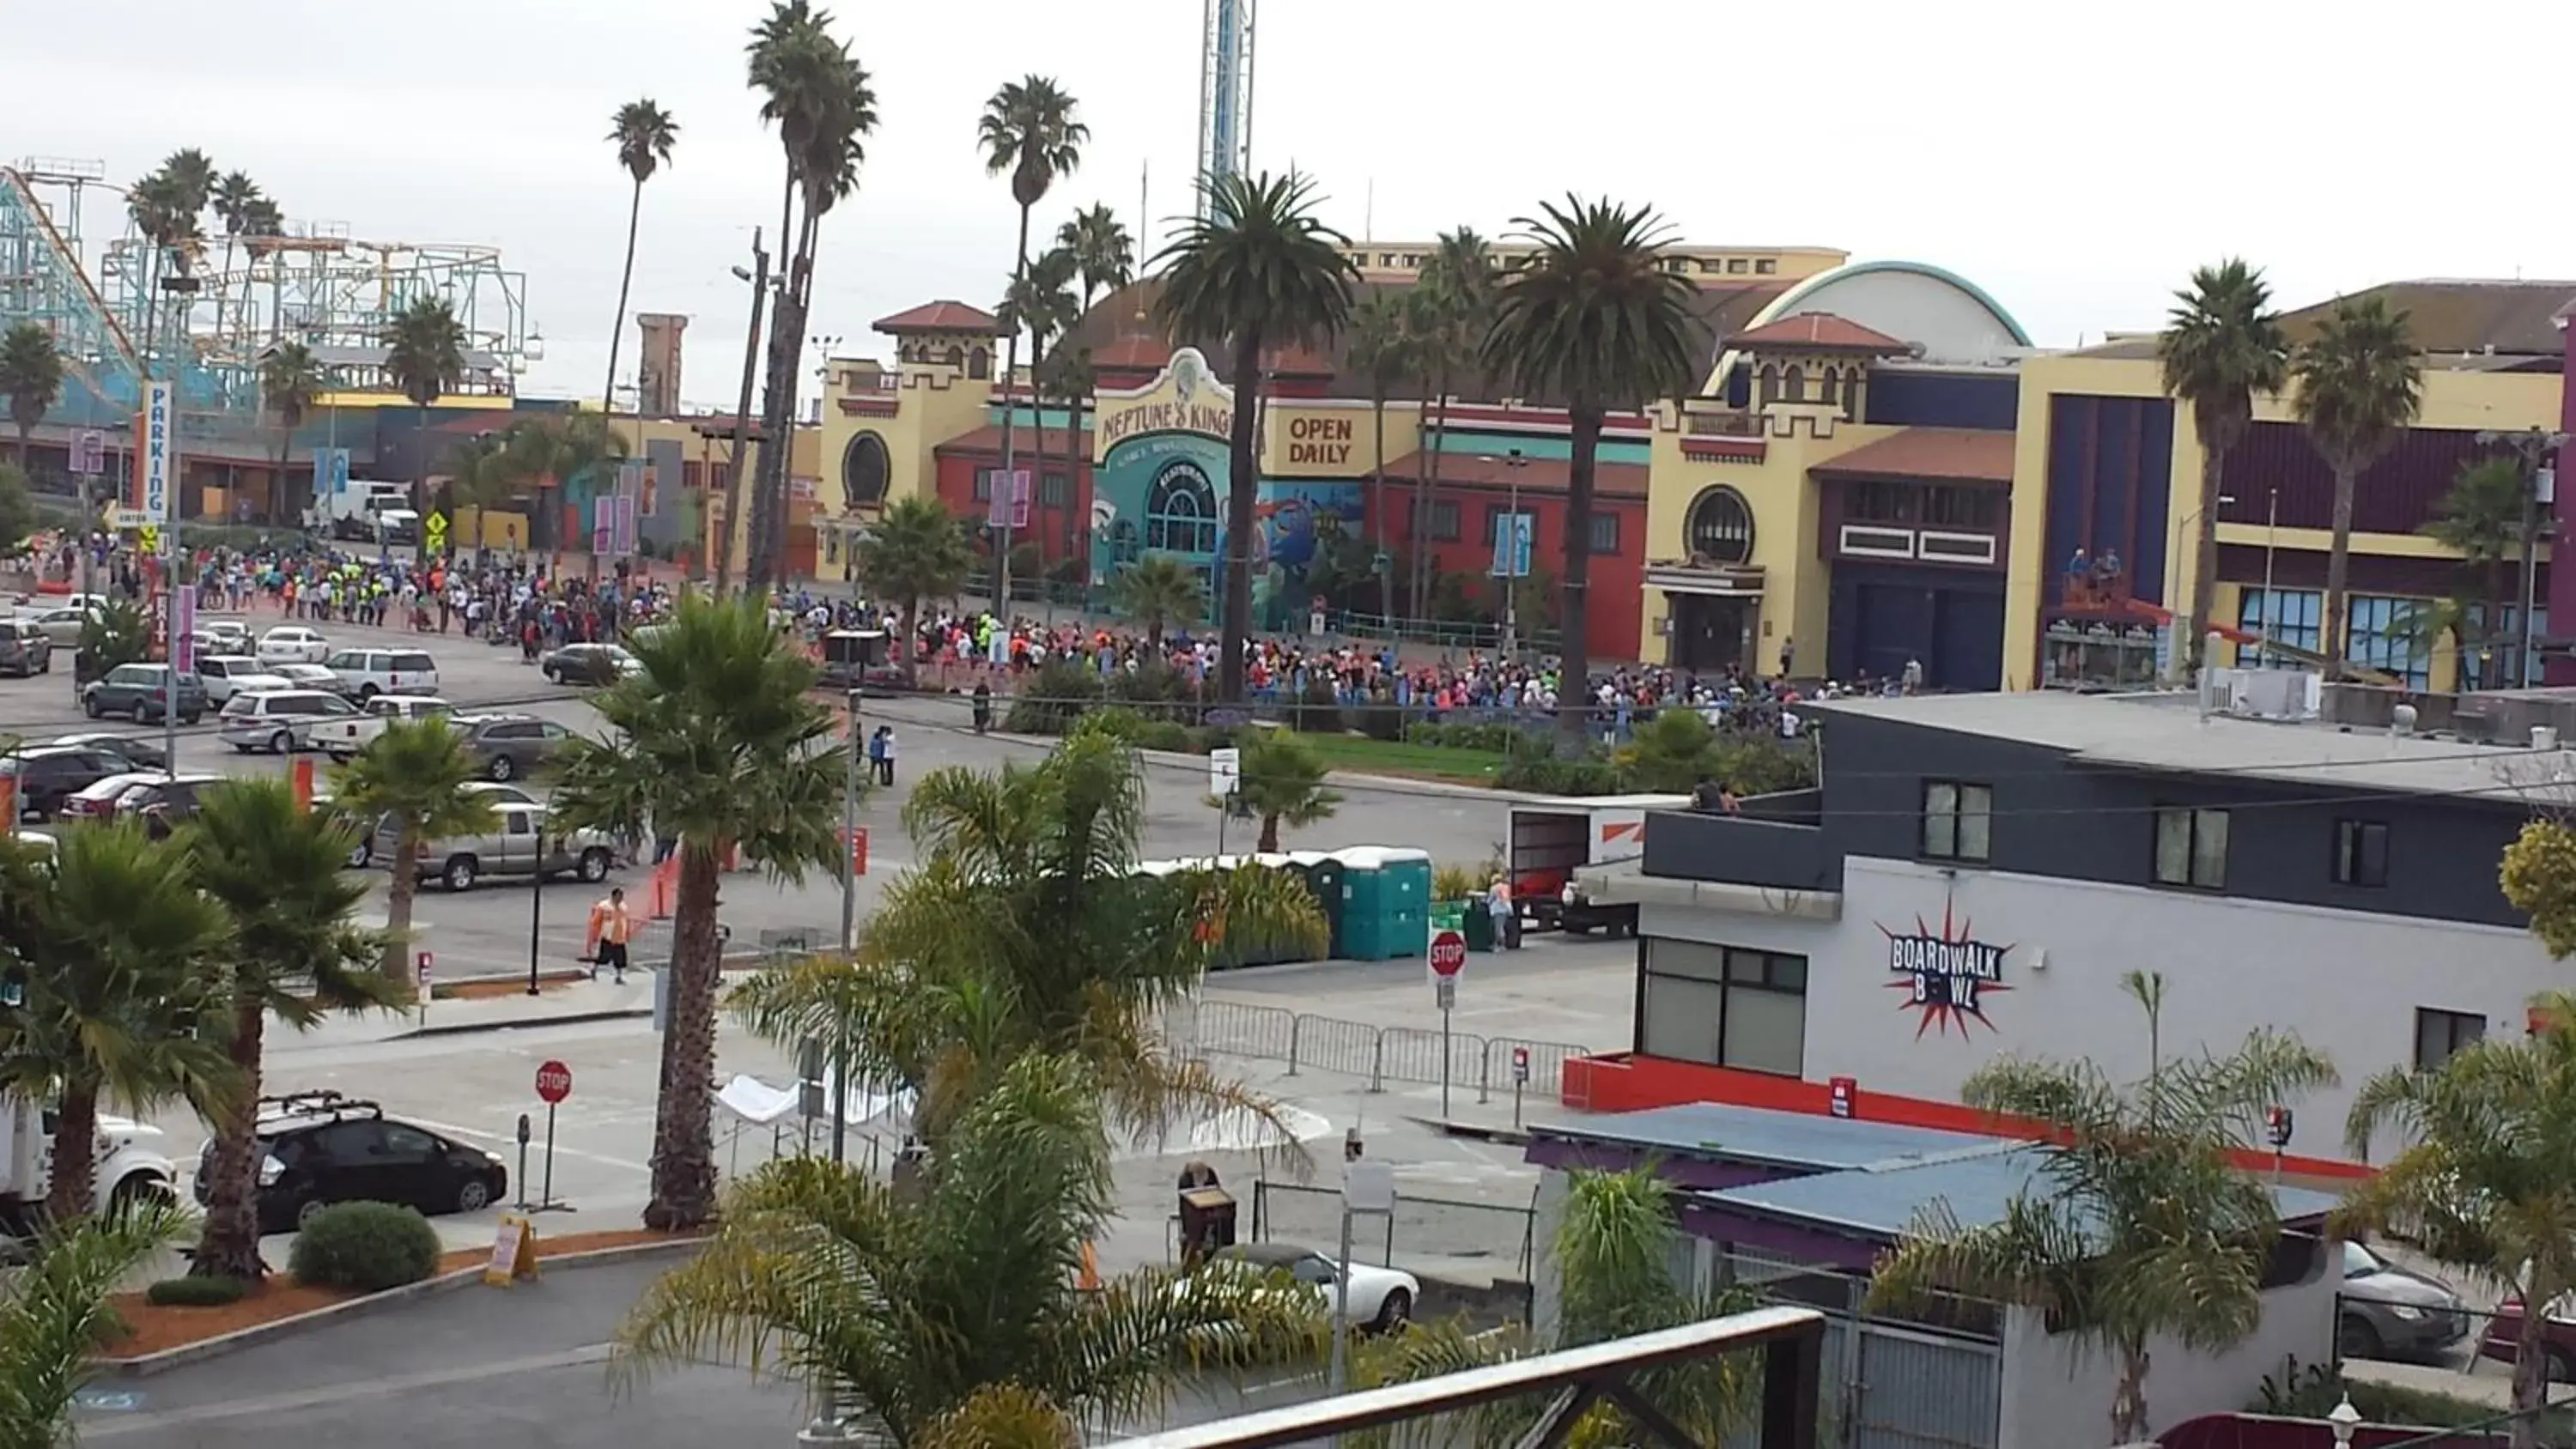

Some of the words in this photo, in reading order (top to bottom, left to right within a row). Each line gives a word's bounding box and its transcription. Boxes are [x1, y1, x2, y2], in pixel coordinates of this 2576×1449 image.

[1103, 401, 1186, 443] NEPTUNE'S
[1190, 403, 1235, 437] KING
[1291, 418, 1352, 440] OPEN
[149, 388, 166, 511] PARKING
[1290, 443, 1352, 464] DAILY
[1432, 944, 1463, 963] STOP
[1893, 938, 1996, 978] BOARDWALK
[538, 1071, 568, 1090] STOP
